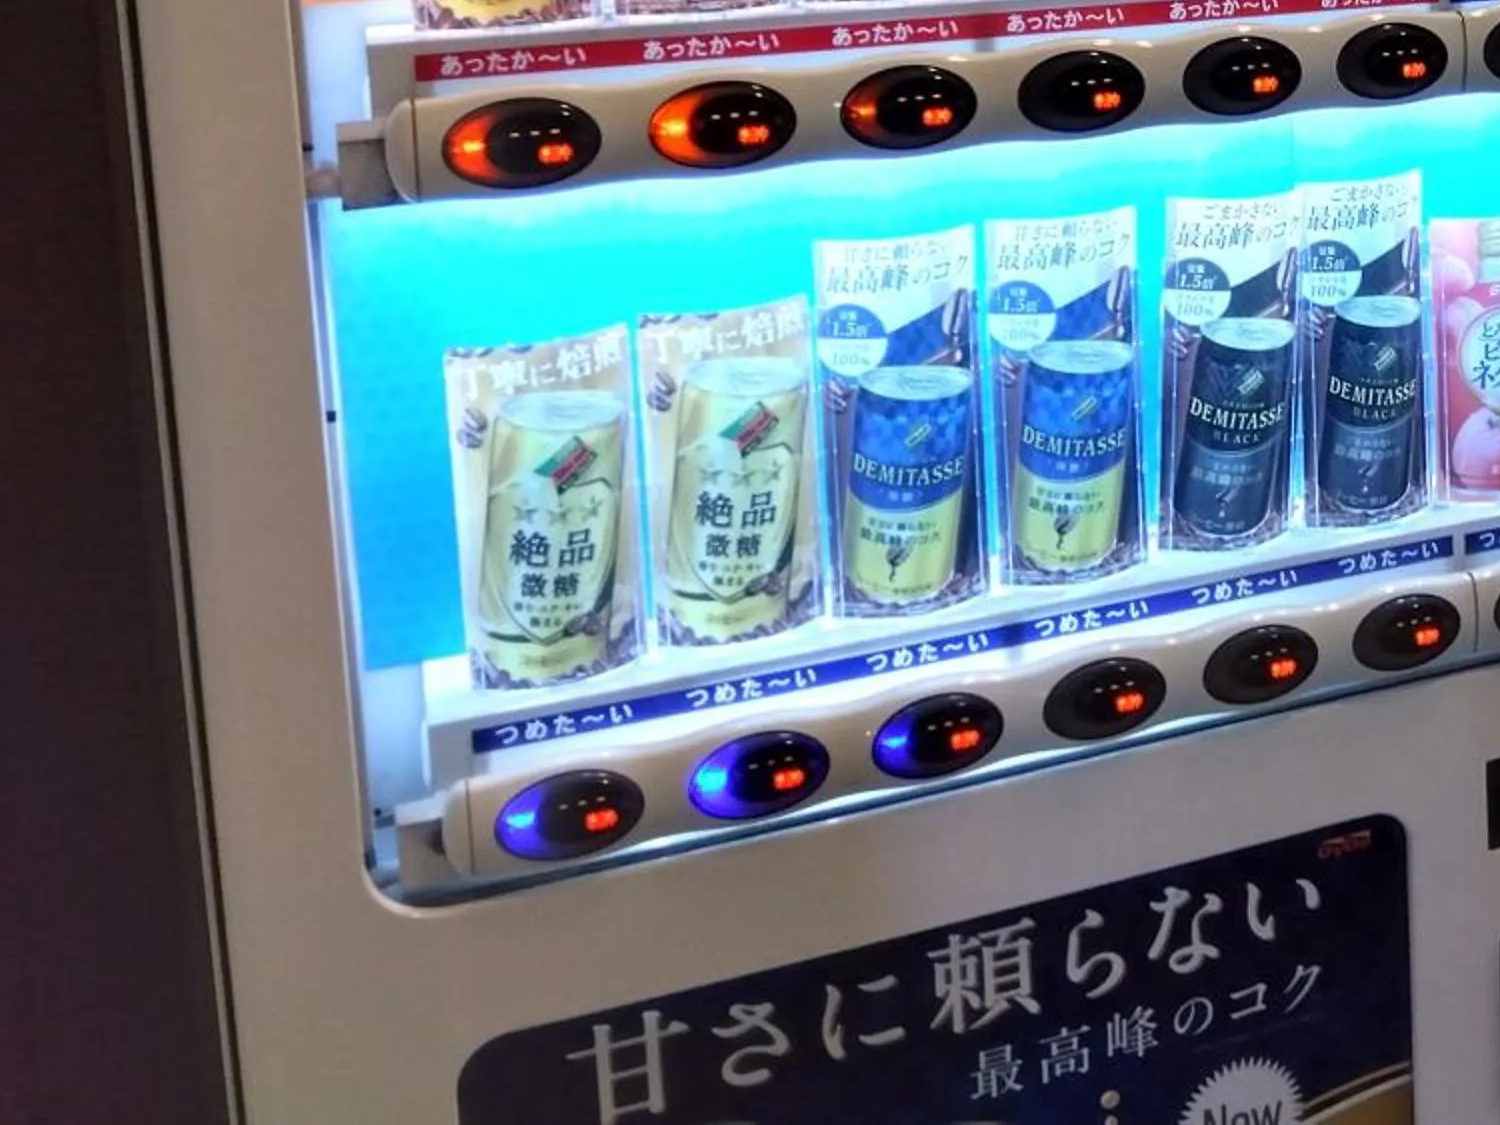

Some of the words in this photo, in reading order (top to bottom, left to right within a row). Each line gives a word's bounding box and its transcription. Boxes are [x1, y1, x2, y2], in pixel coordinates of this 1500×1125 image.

[1306, 194, 1420, 232] 最高峰のコ
[996, 231, 1131, 272] 最高峰のコク
[826, 253, 969, 295] 最高峰のコク
[1329, 375, 1418, 406] DEMITASSE
[1189, 396, 1285, 431] DEMITASSE
[1022, 424, 1126, 457] DEMITASSE
[853, 452, 965, 488] DEMITASSE
[694, 490, 776, 530] 絶品
[510, 527, 596, 570] 絶品
[704, 533, 763, 559] 微糖
[520, 572, 581, 599] 微糖
[566, 877, 1322, 1125] 甘さに頼らない
[969, 963, 1323, 1101] 最高峰のコク
[1203, 1099, 1283, 1125] New
